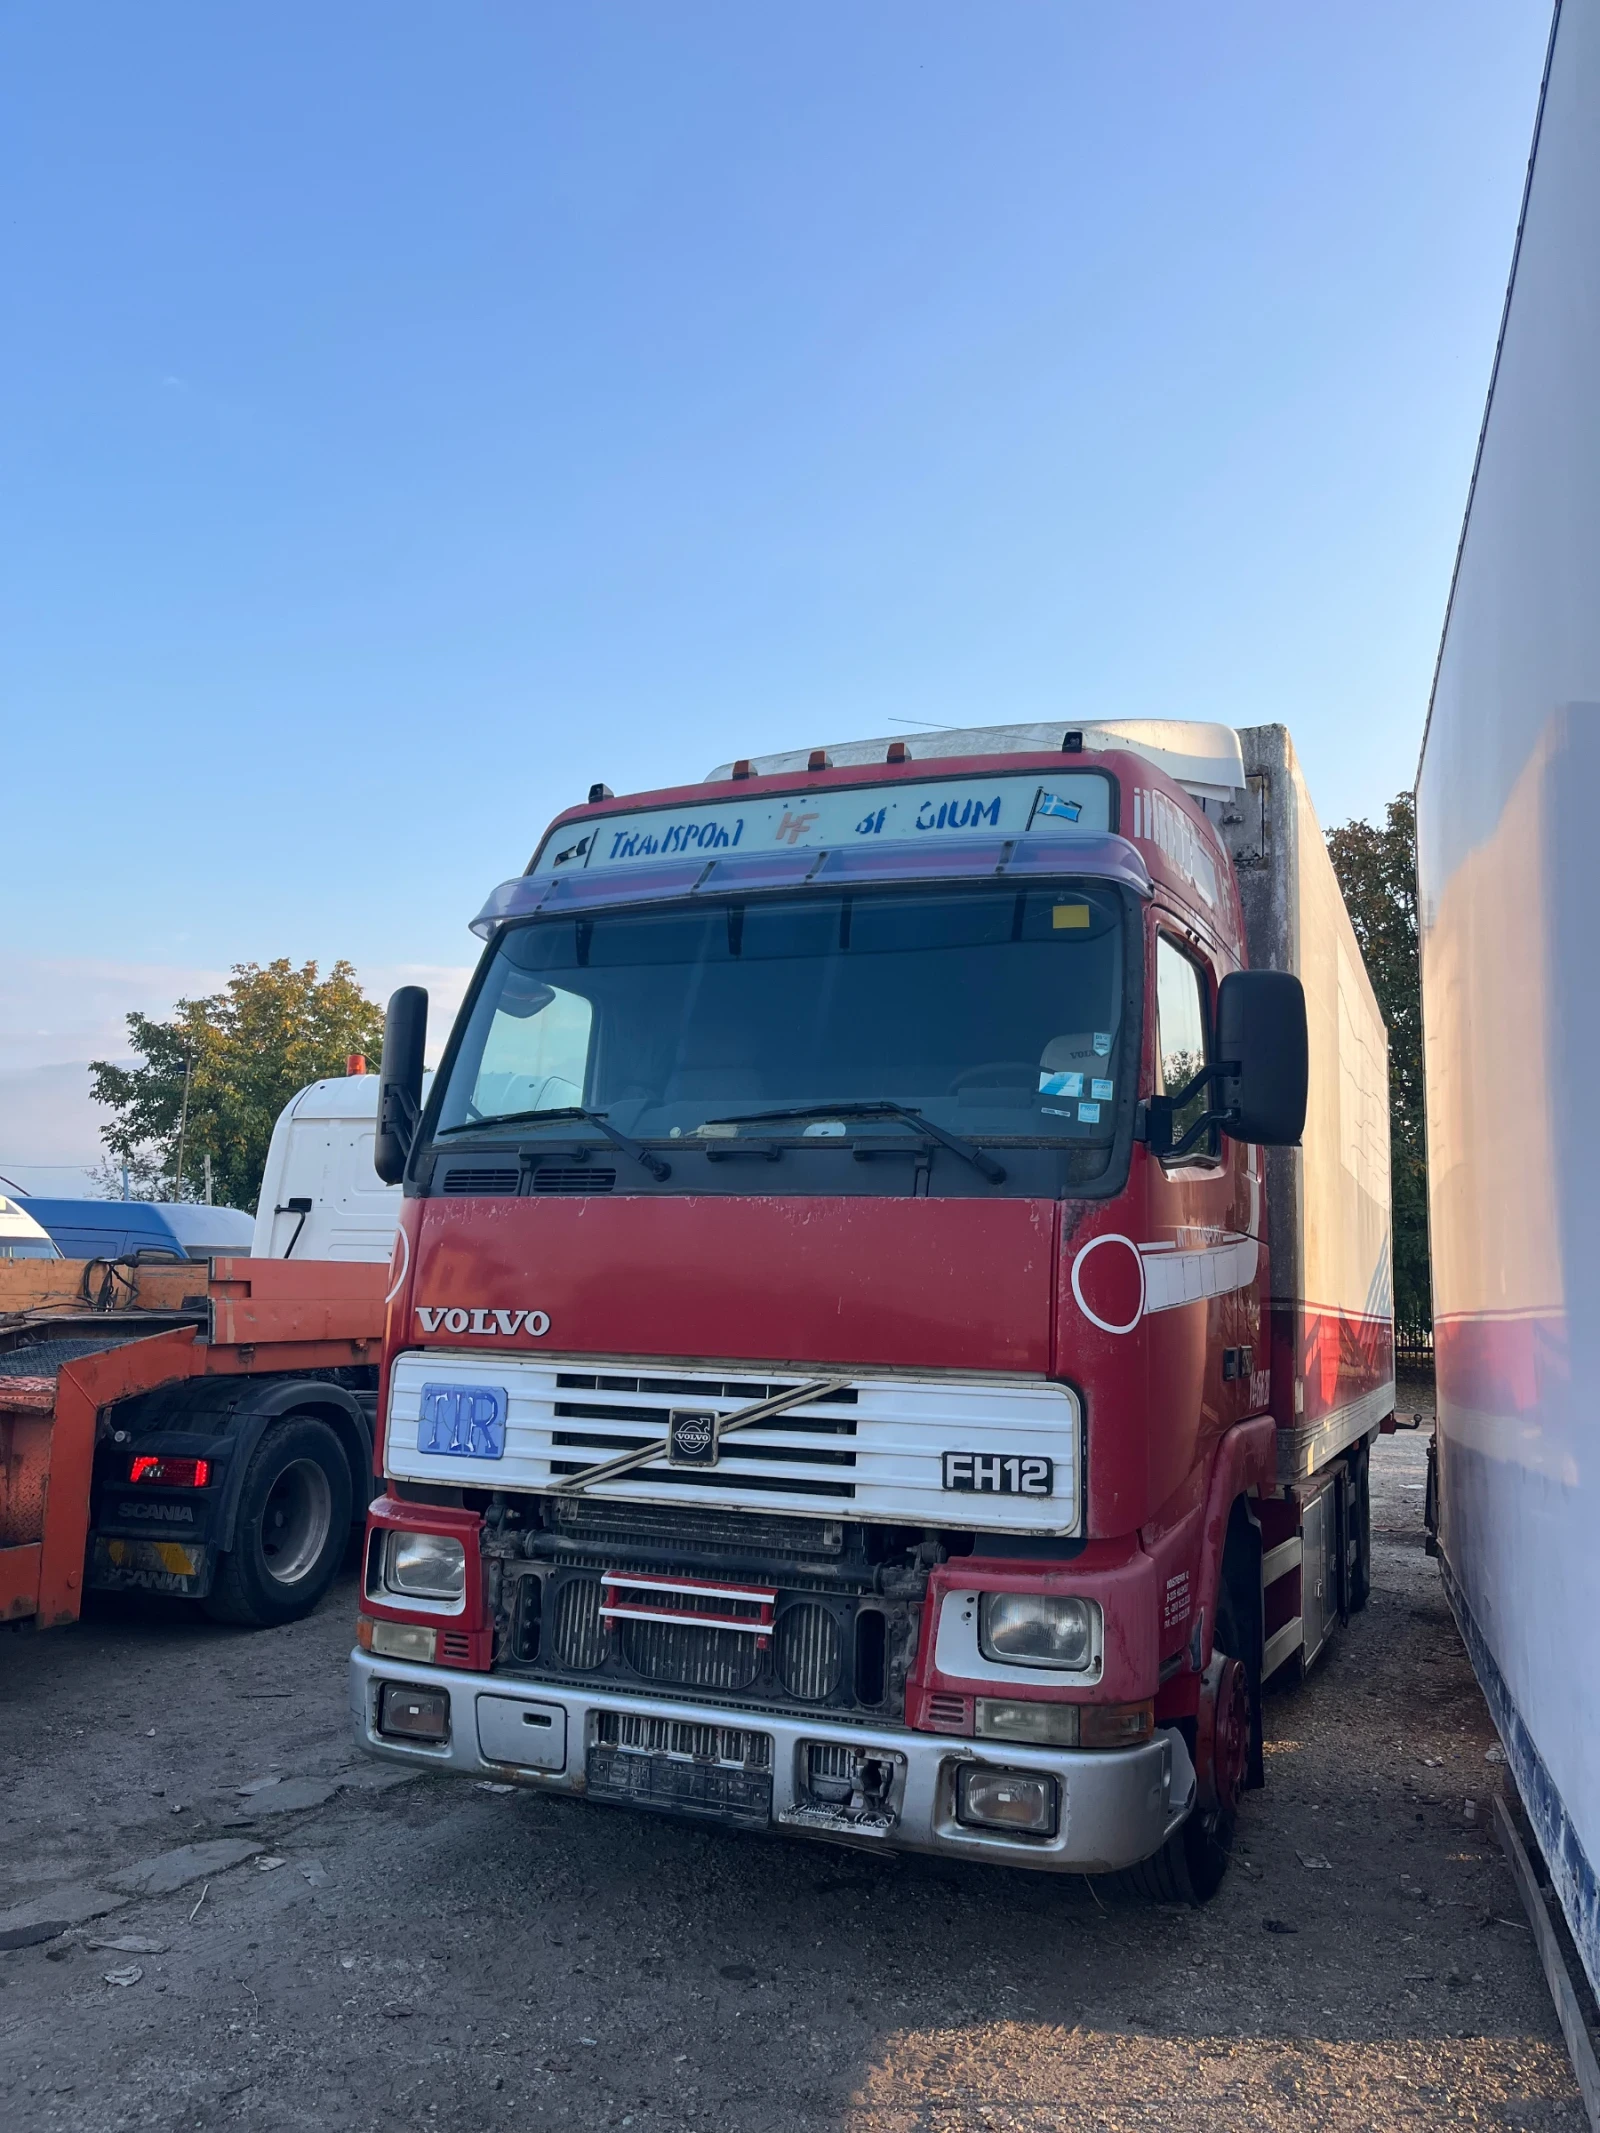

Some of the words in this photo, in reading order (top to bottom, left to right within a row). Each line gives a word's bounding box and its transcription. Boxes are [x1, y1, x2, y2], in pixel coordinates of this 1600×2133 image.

[415, 1307, 551, 1337] VOLVO
[424, 1388, 499, 1454] TIR
[677, 1433, 709, 1441] VOLVO
[946, 1454, 1048, 1494] FH12
[118, 1502, 194, 1523] SCANIA
